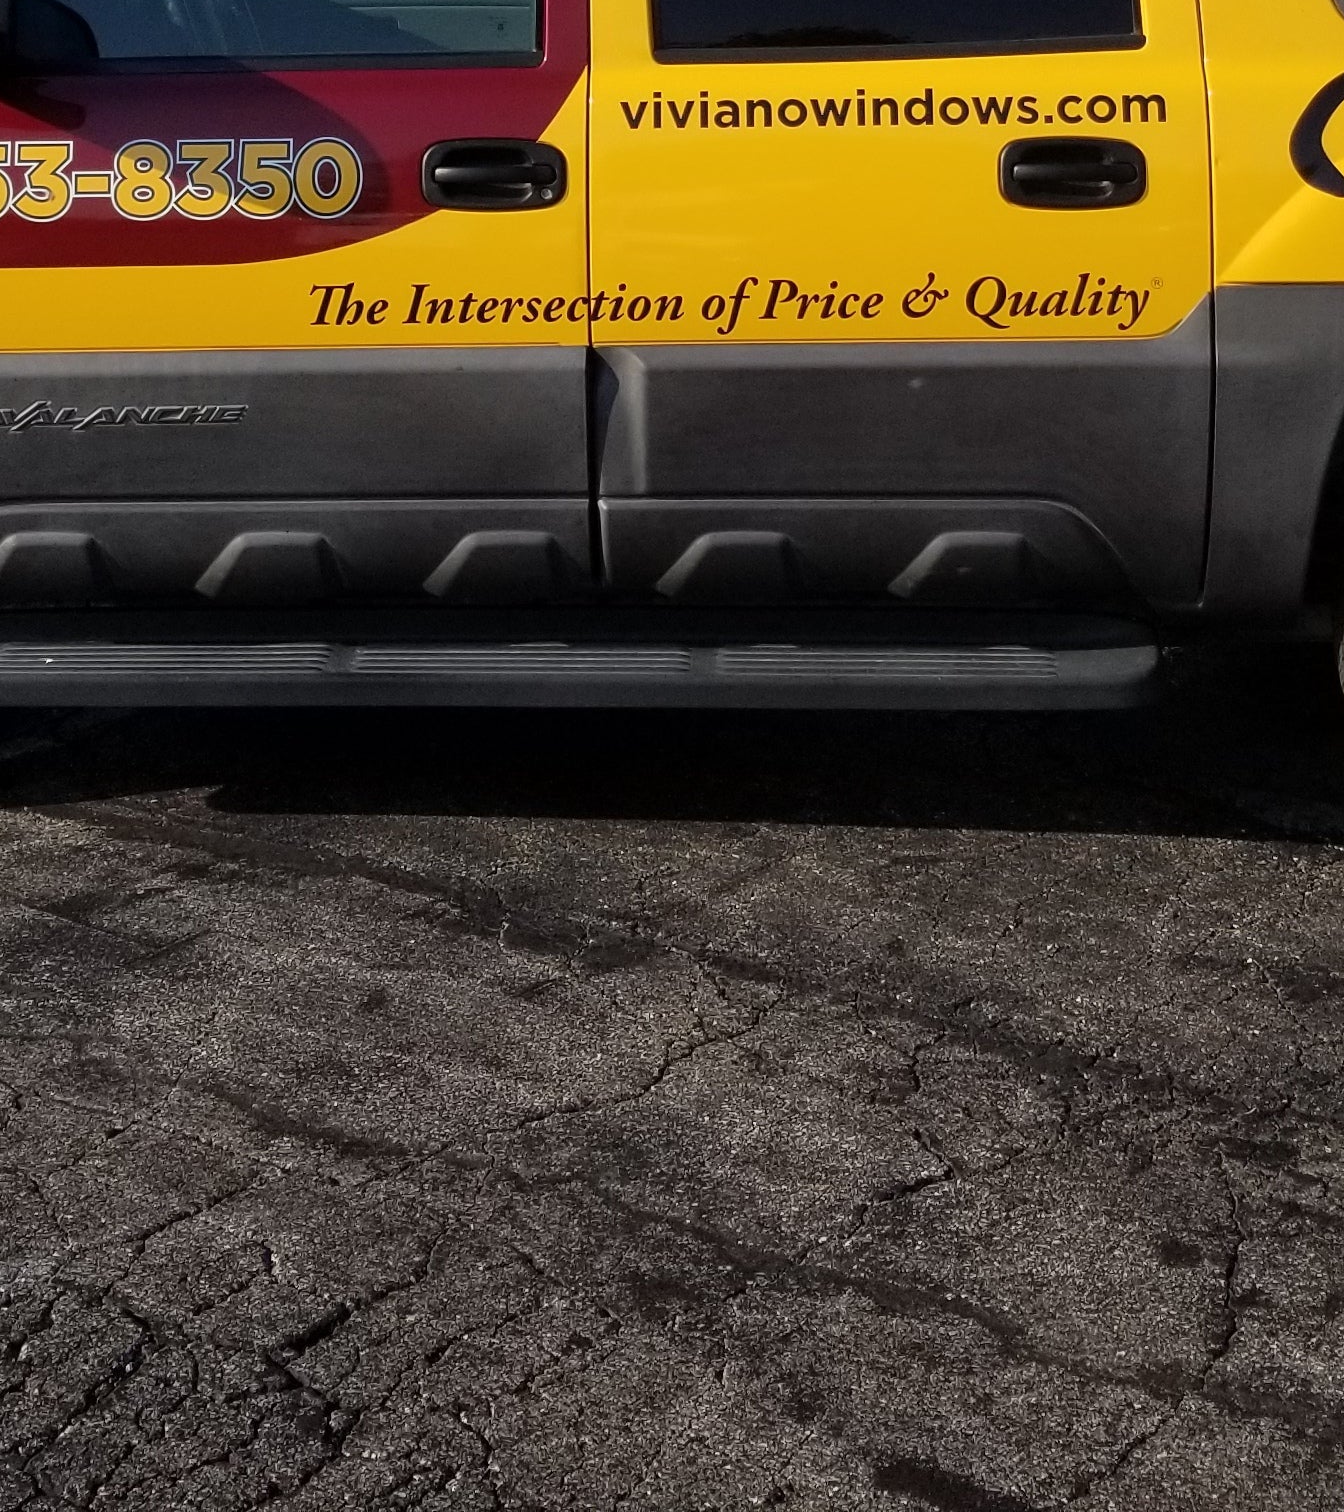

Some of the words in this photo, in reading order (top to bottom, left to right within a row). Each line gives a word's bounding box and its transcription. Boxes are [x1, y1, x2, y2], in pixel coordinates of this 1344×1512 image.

[619, 88, 1168, 130] vivianowindows.com
[308, 281, 390, 326] The
[401, 282, 685, 325] Intersection
[701, 276, 759, 336] of
[758, 278, 884, 321] Price
[901, 271, 950, 320] &
